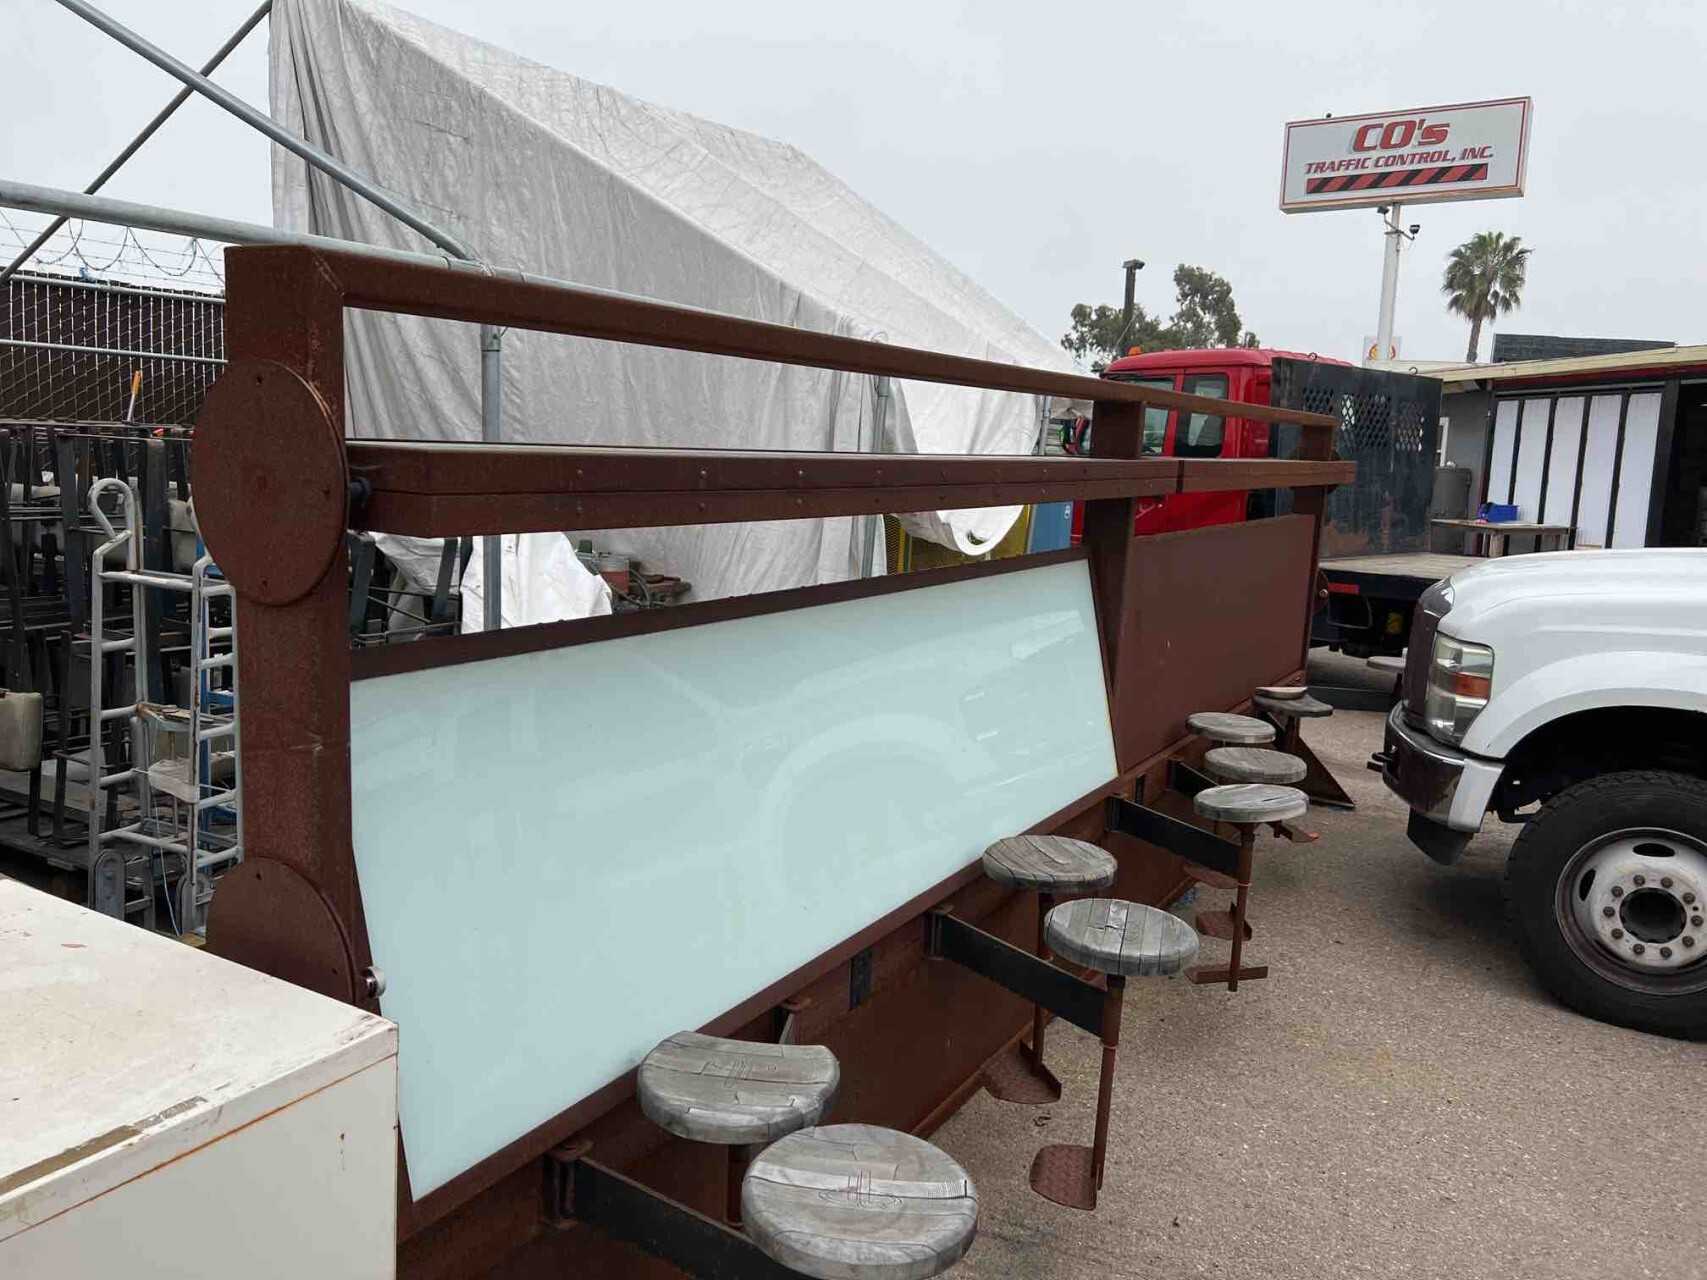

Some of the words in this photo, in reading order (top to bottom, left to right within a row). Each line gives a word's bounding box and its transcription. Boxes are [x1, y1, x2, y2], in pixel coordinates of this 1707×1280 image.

[1353, 119, 1450, 152] CO's
[1305, 156, 1370, 174] TRAFFIC
[1374, 150, 1456, 168] CONTROL,
[1460, 145, 1494, 161] INC.
